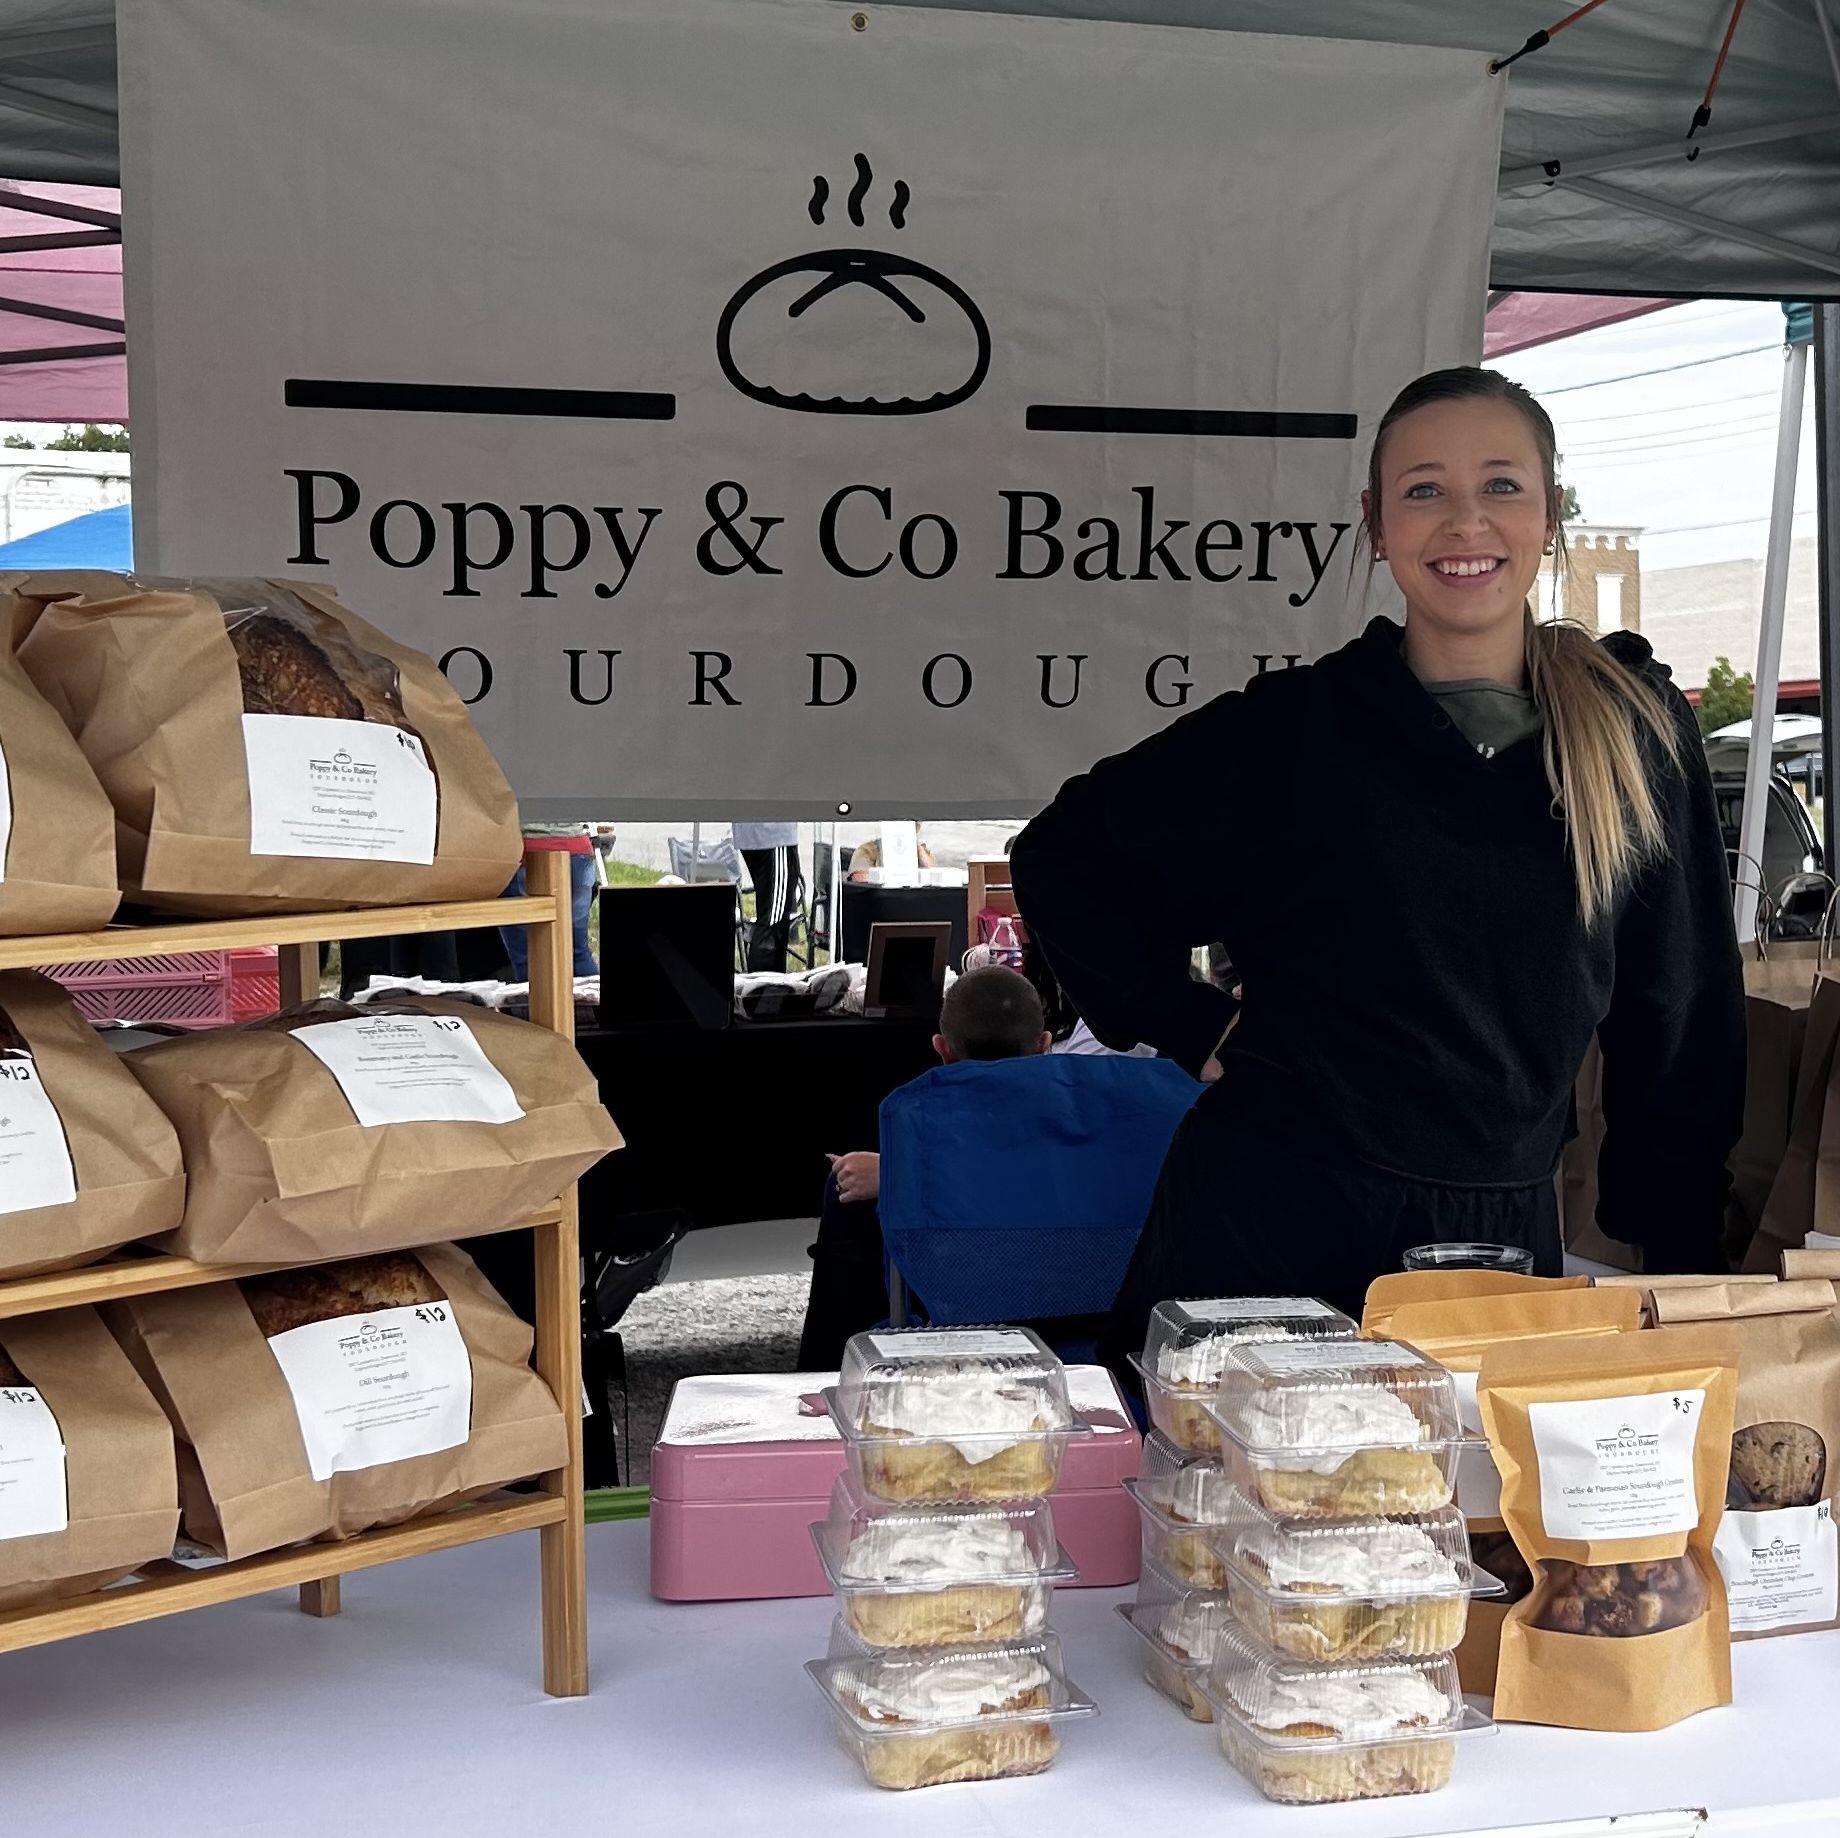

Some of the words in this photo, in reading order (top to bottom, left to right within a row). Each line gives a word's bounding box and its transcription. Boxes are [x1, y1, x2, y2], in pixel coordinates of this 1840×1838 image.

[283, 468, 663, 600] Poppy
[696, 480, 785, 576] &
[818, 484, 959, 580] Co
[994, 486, 1352, 608] Bakery
[433, 1020, 462, 1032] $12
[415, 1306, 446, 1324] $12
[2, 1389, 36, 1404] $12
[1672, 1396, 1695, 1414] $5
